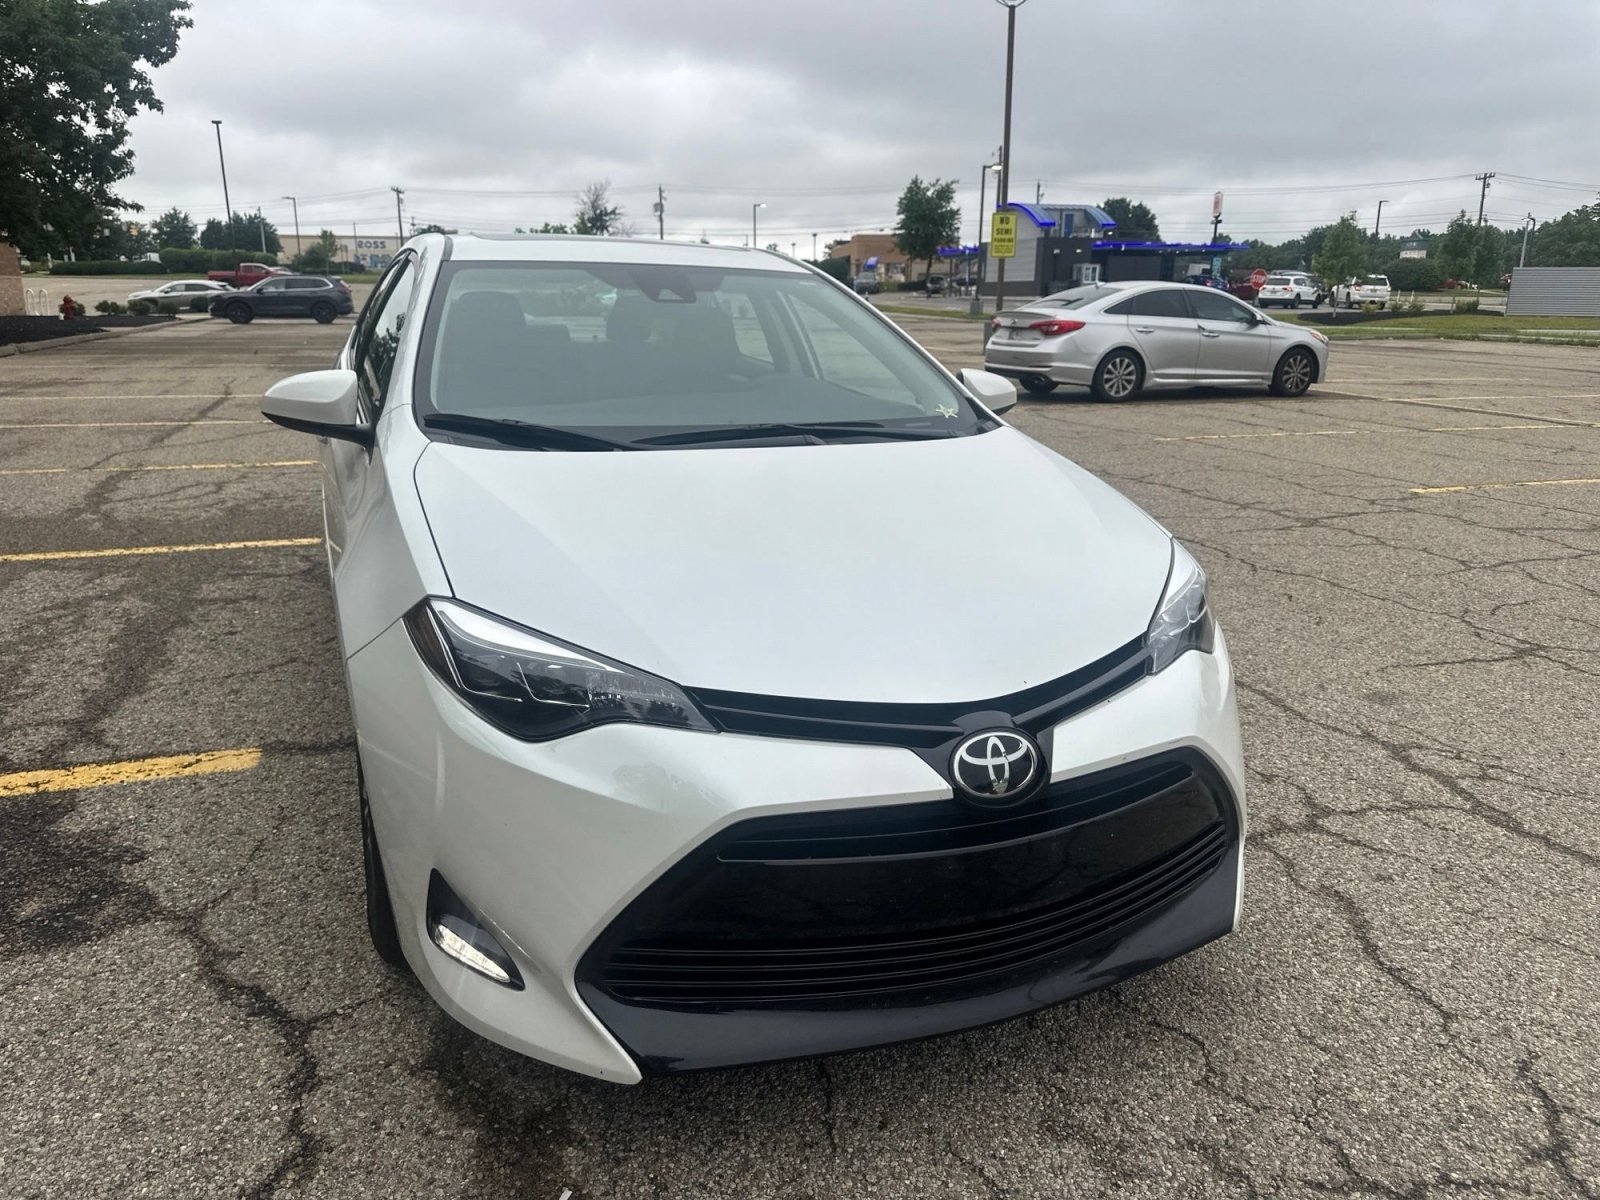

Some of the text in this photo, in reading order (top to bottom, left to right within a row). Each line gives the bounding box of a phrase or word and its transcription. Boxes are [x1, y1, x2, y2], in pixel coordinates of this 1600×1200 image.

[1000, 217, 1010, 225] NO
[996, 228, 1013, 236] SEMI
[358, 241, 386, 249] ROSS
